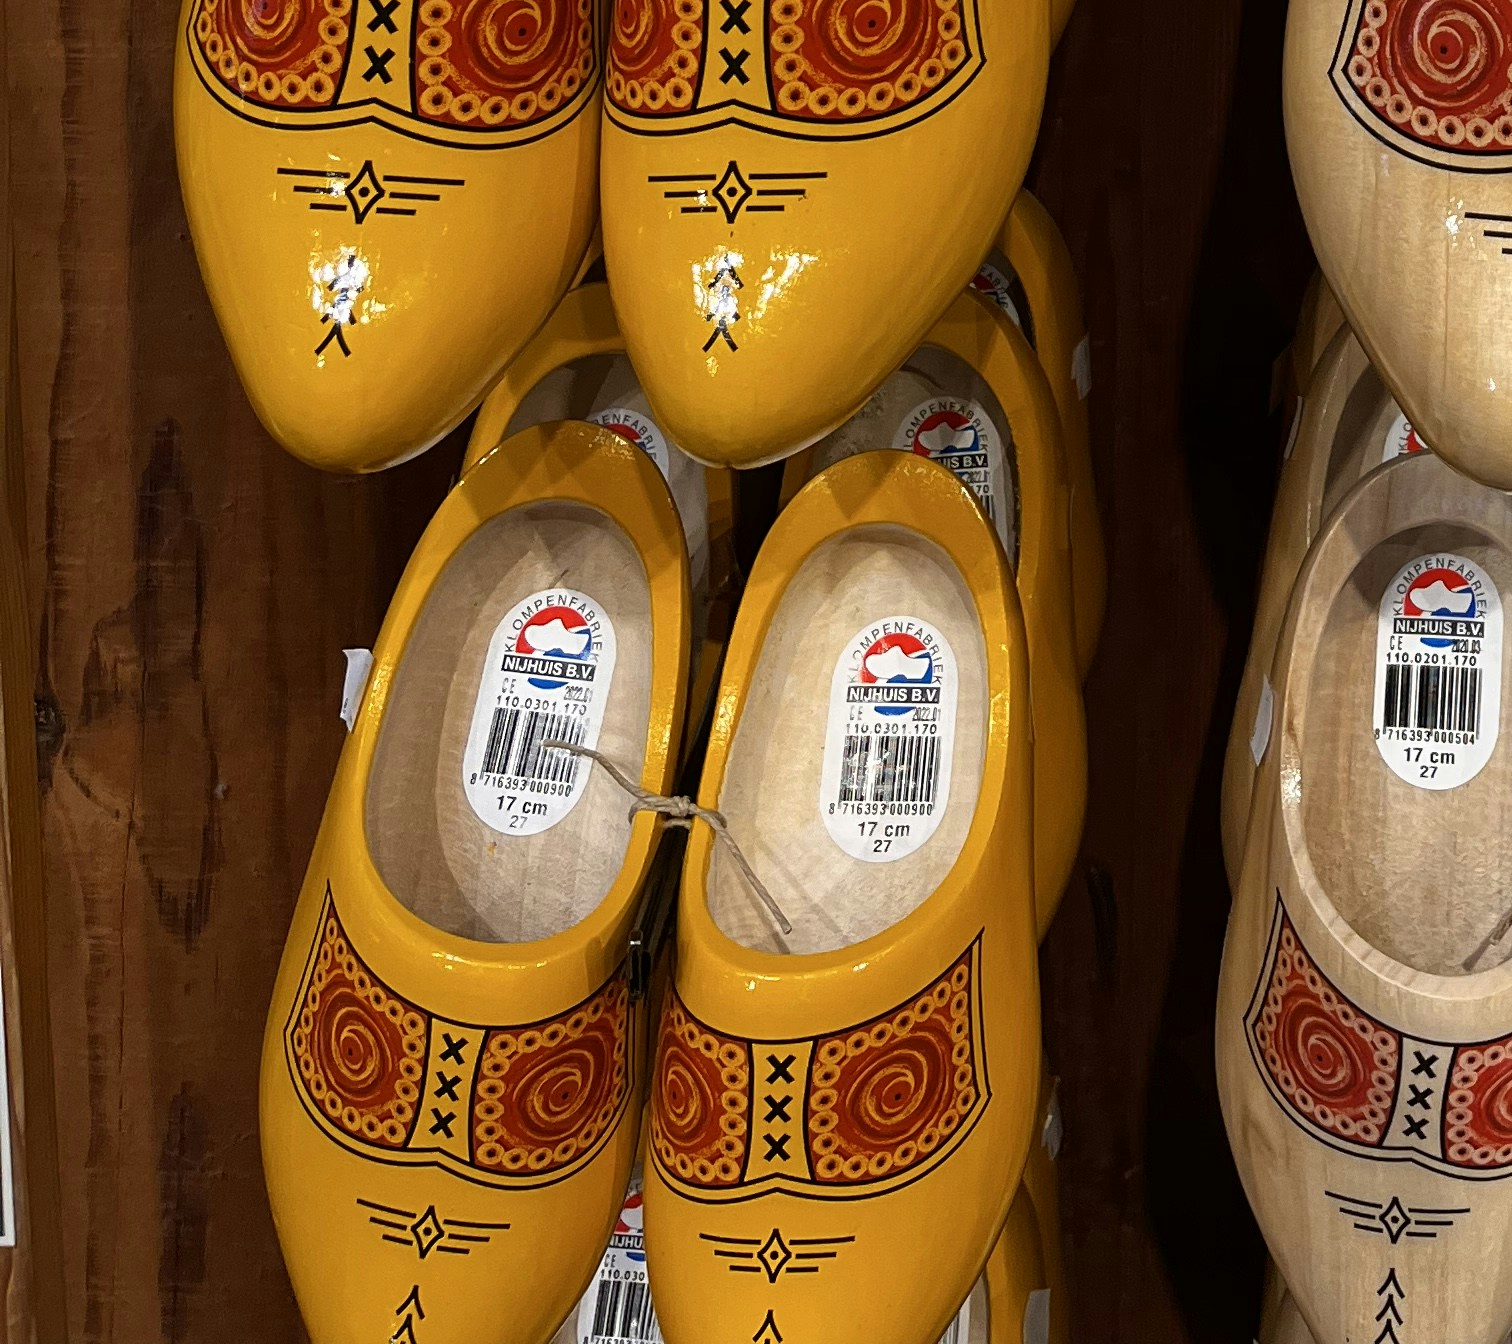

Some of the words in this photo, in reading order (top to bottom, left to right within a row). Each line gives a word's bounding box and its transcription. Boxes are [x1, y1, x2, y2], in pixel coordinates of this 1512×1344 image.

[903, 402, 987, 452] LOMPENFABRIEK
[1394, 558, 1487, 619] KLOMPENFABRIEK
[504, 595, 602, 662] KLOMPENFABRIEK
[1396, 619, 1452, 634] NIJHUIS
[1458, 622, 1484, 636] B.V.
[1387, 653, 1476, 666] 110.0201.170
[504, 656, 563, 675] NIJHUIS
[567, 663, 593, 680] B.V.
[849, 688, 907, 702] NIJHUIS
[912, 688, 938, 701] B.V.
[497, 695, 586, 715] 110.0301.170
[1404, 748, 1422, 763] 17
[1430, 752, 1455, 764] cm
[1420, 766, 1437, 778] 27
[496, 795, 516, 810] 17
[522, 801, 547, 815] cm
[510, 815, 528, 828] 27
[858, 822, 878, 837] 17
[885, 823, 910, 836] cm
[874, 840, 892, 853] 27
